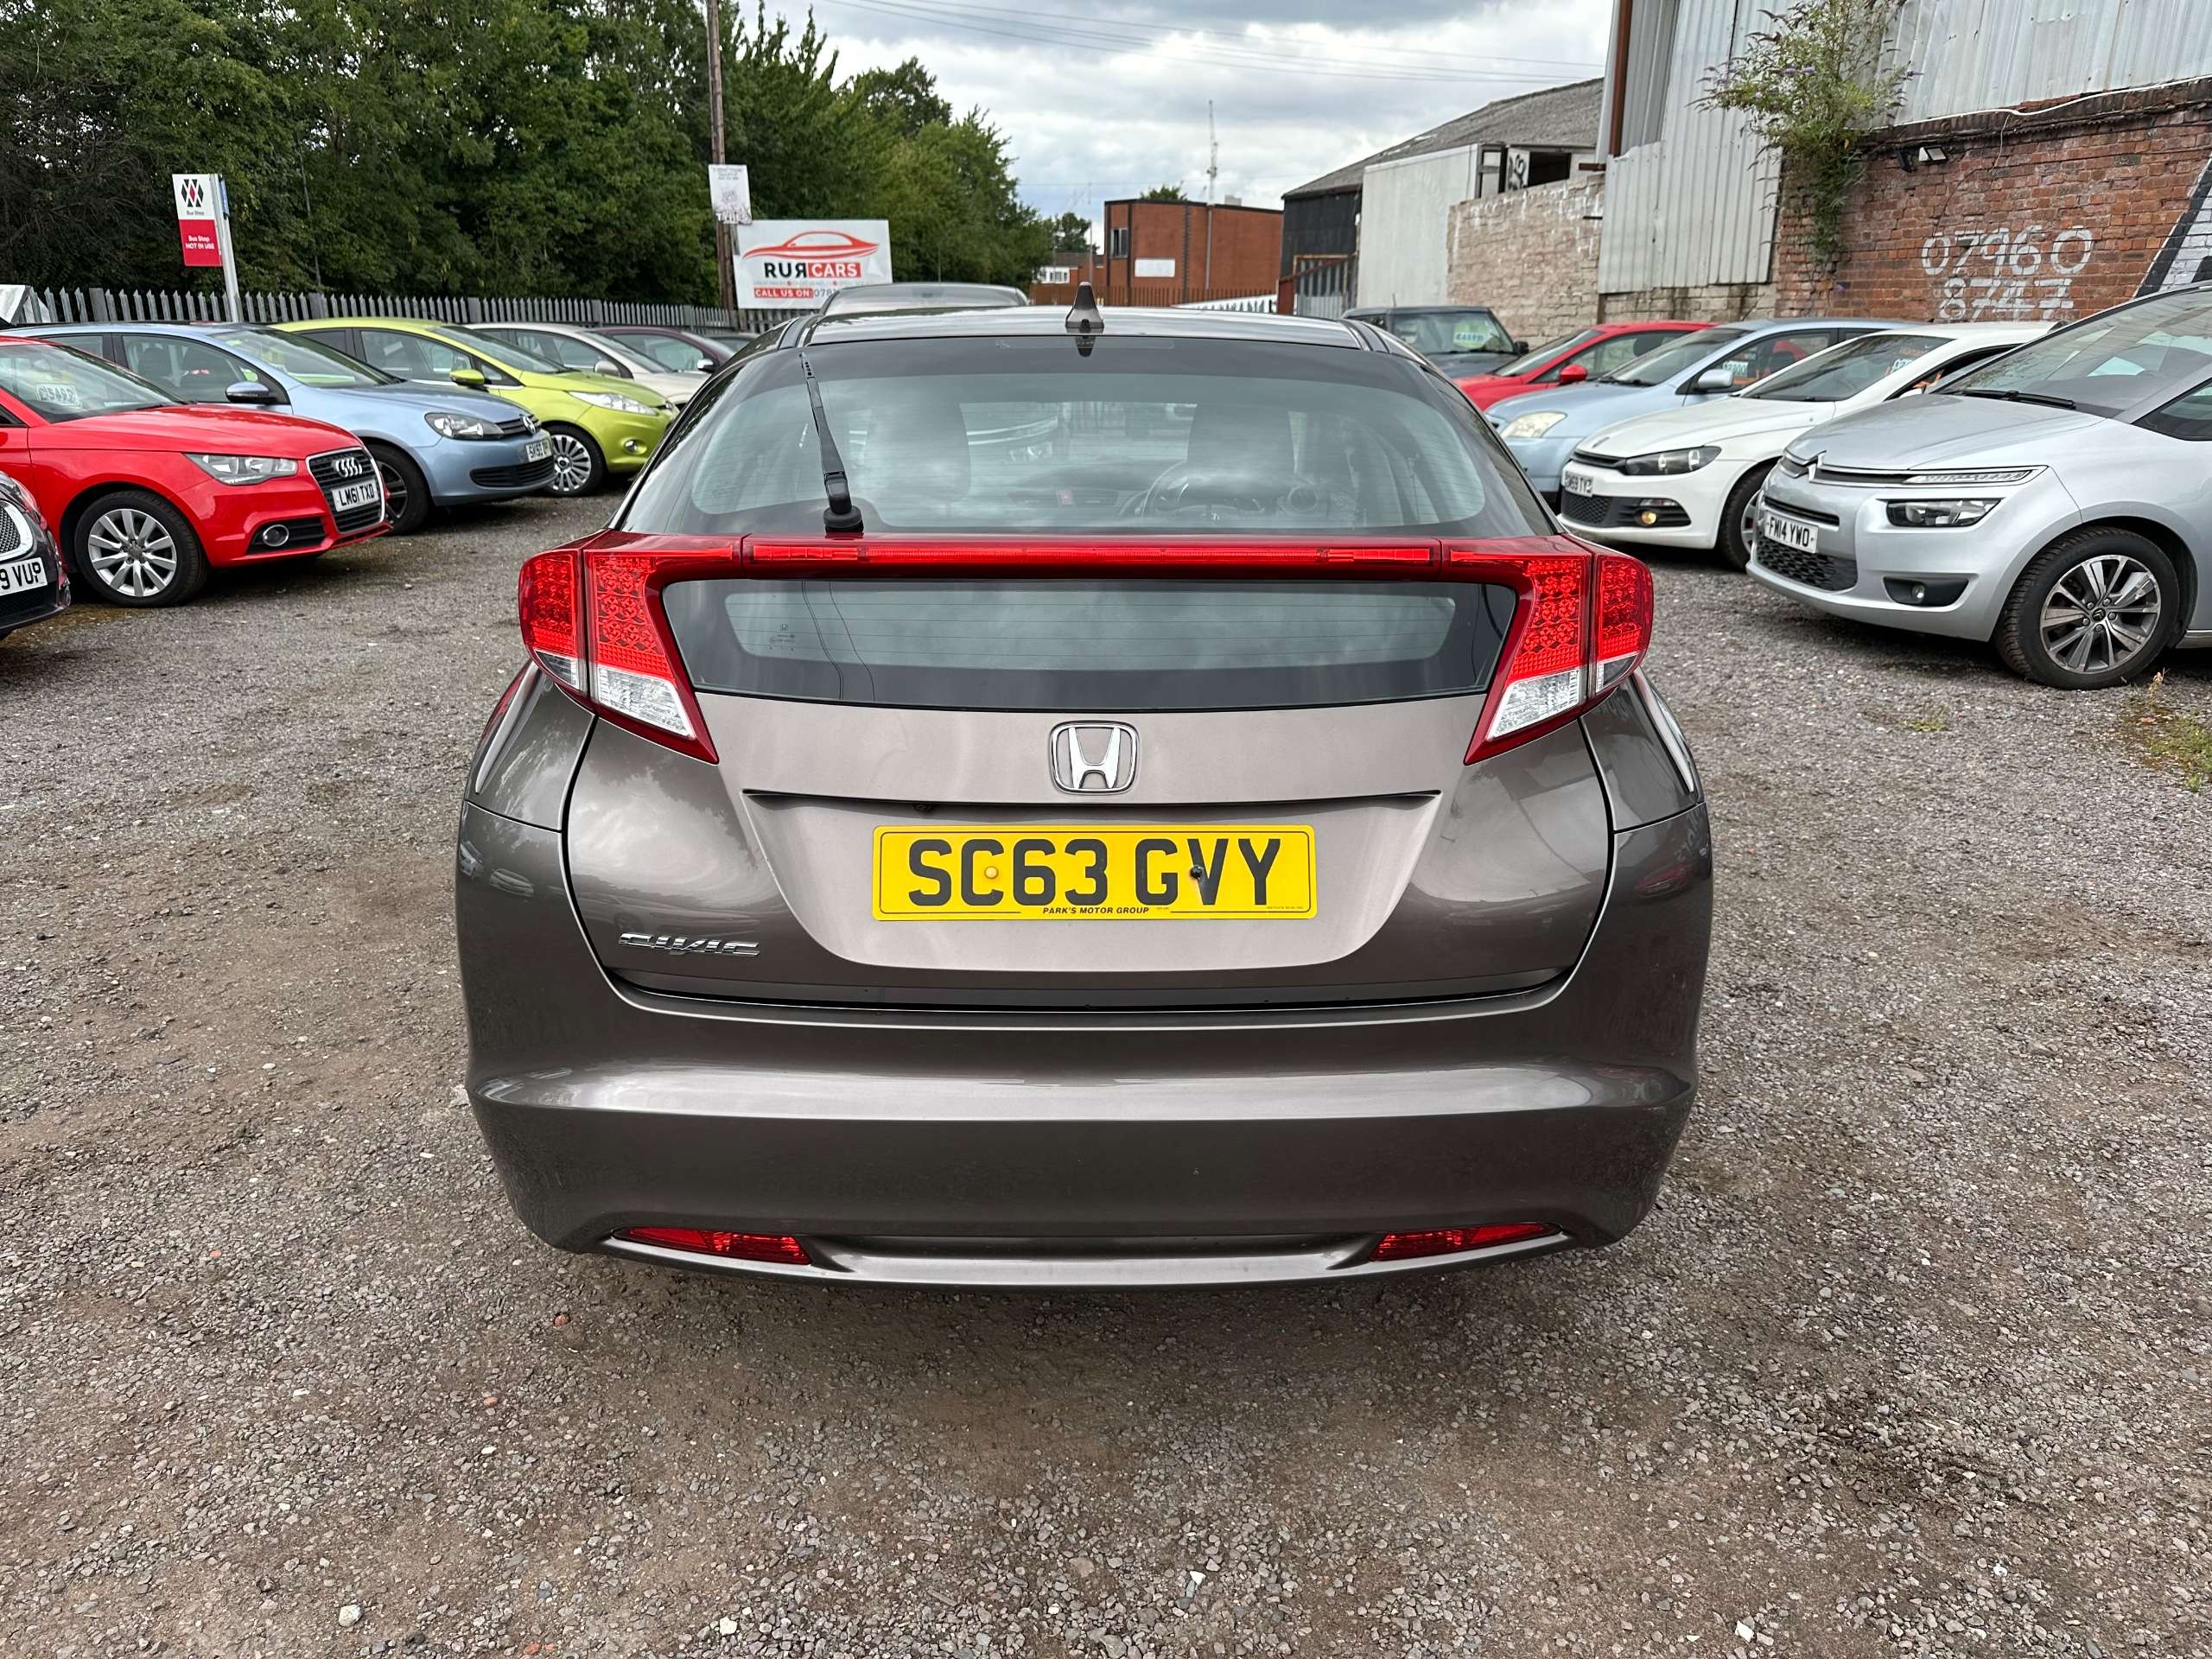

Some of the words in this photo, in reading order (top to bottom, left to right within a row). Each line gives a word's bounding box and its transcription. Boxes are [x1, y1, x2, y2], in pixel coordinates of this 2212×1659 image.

[1921, 225, 2094, 276] 07960
[755, 289, 778, 297] CALL
[779, 289, 792, 297] US
[795, 289, 810, 297] ON
[1939, 276, 2074, 323] 8747
[338, 486, 360, 506] LM61
[359, 483, 374, 501] TXD
[1769, 516, 1788, 542] FM14
[11, 561, 41, 588] VUP
[908, 838, 1109, 906] SC63
[1135, 838, 1281, 906] GVY
[1079, 906, 1115, 915] MOTOR
[1116, 906, 1150, 915] GROUP
[618, 931, 761, 957] CIVIC
